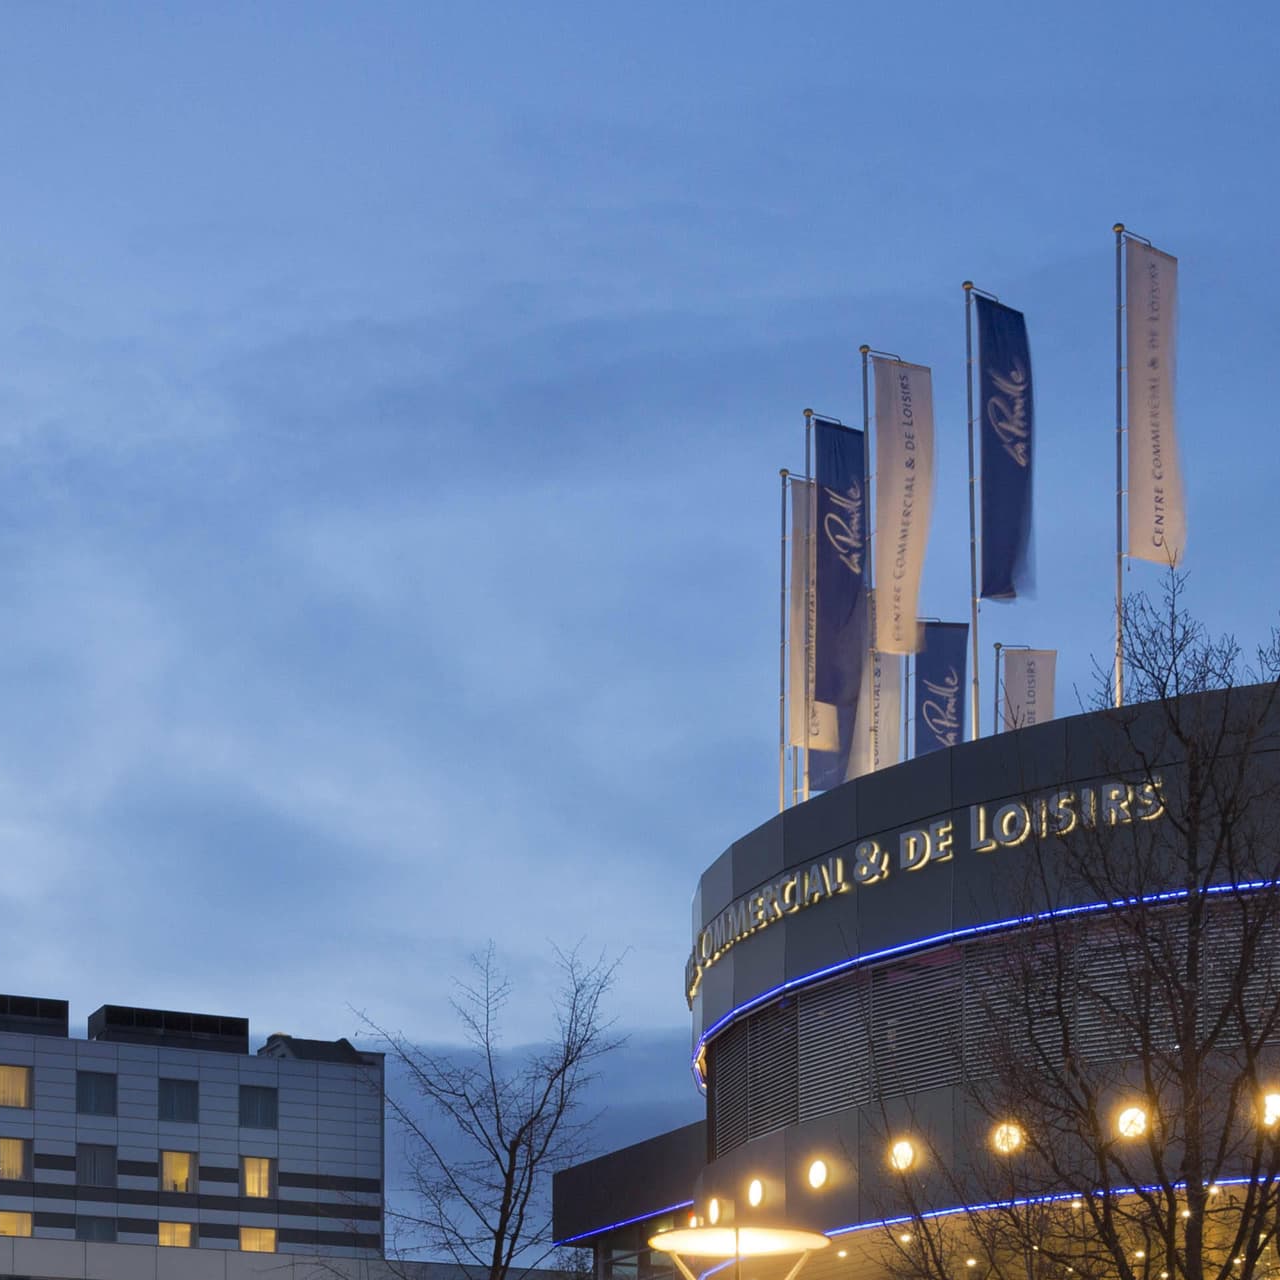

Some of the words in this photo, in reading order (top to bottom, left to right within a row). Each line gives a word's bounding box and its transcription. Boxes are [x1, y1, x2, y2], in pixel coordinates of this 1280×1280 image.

[898, 374, 915, 429] LOISIRS
[905, 431, 916, 450] DE
[905, 459, 915, 470] &
[893, 475, 916, 579] COMMERCIAL
[1152, 487, 1166, 548] CENTRE
[1027, 660, 1036, 701] LOISIRS
[1027, 706, 1036, 725] DE
[853, 839, 890, 886] &
[899, 818, 954, 873] DE
[969, 775, 1169, 854] LOISIRS
